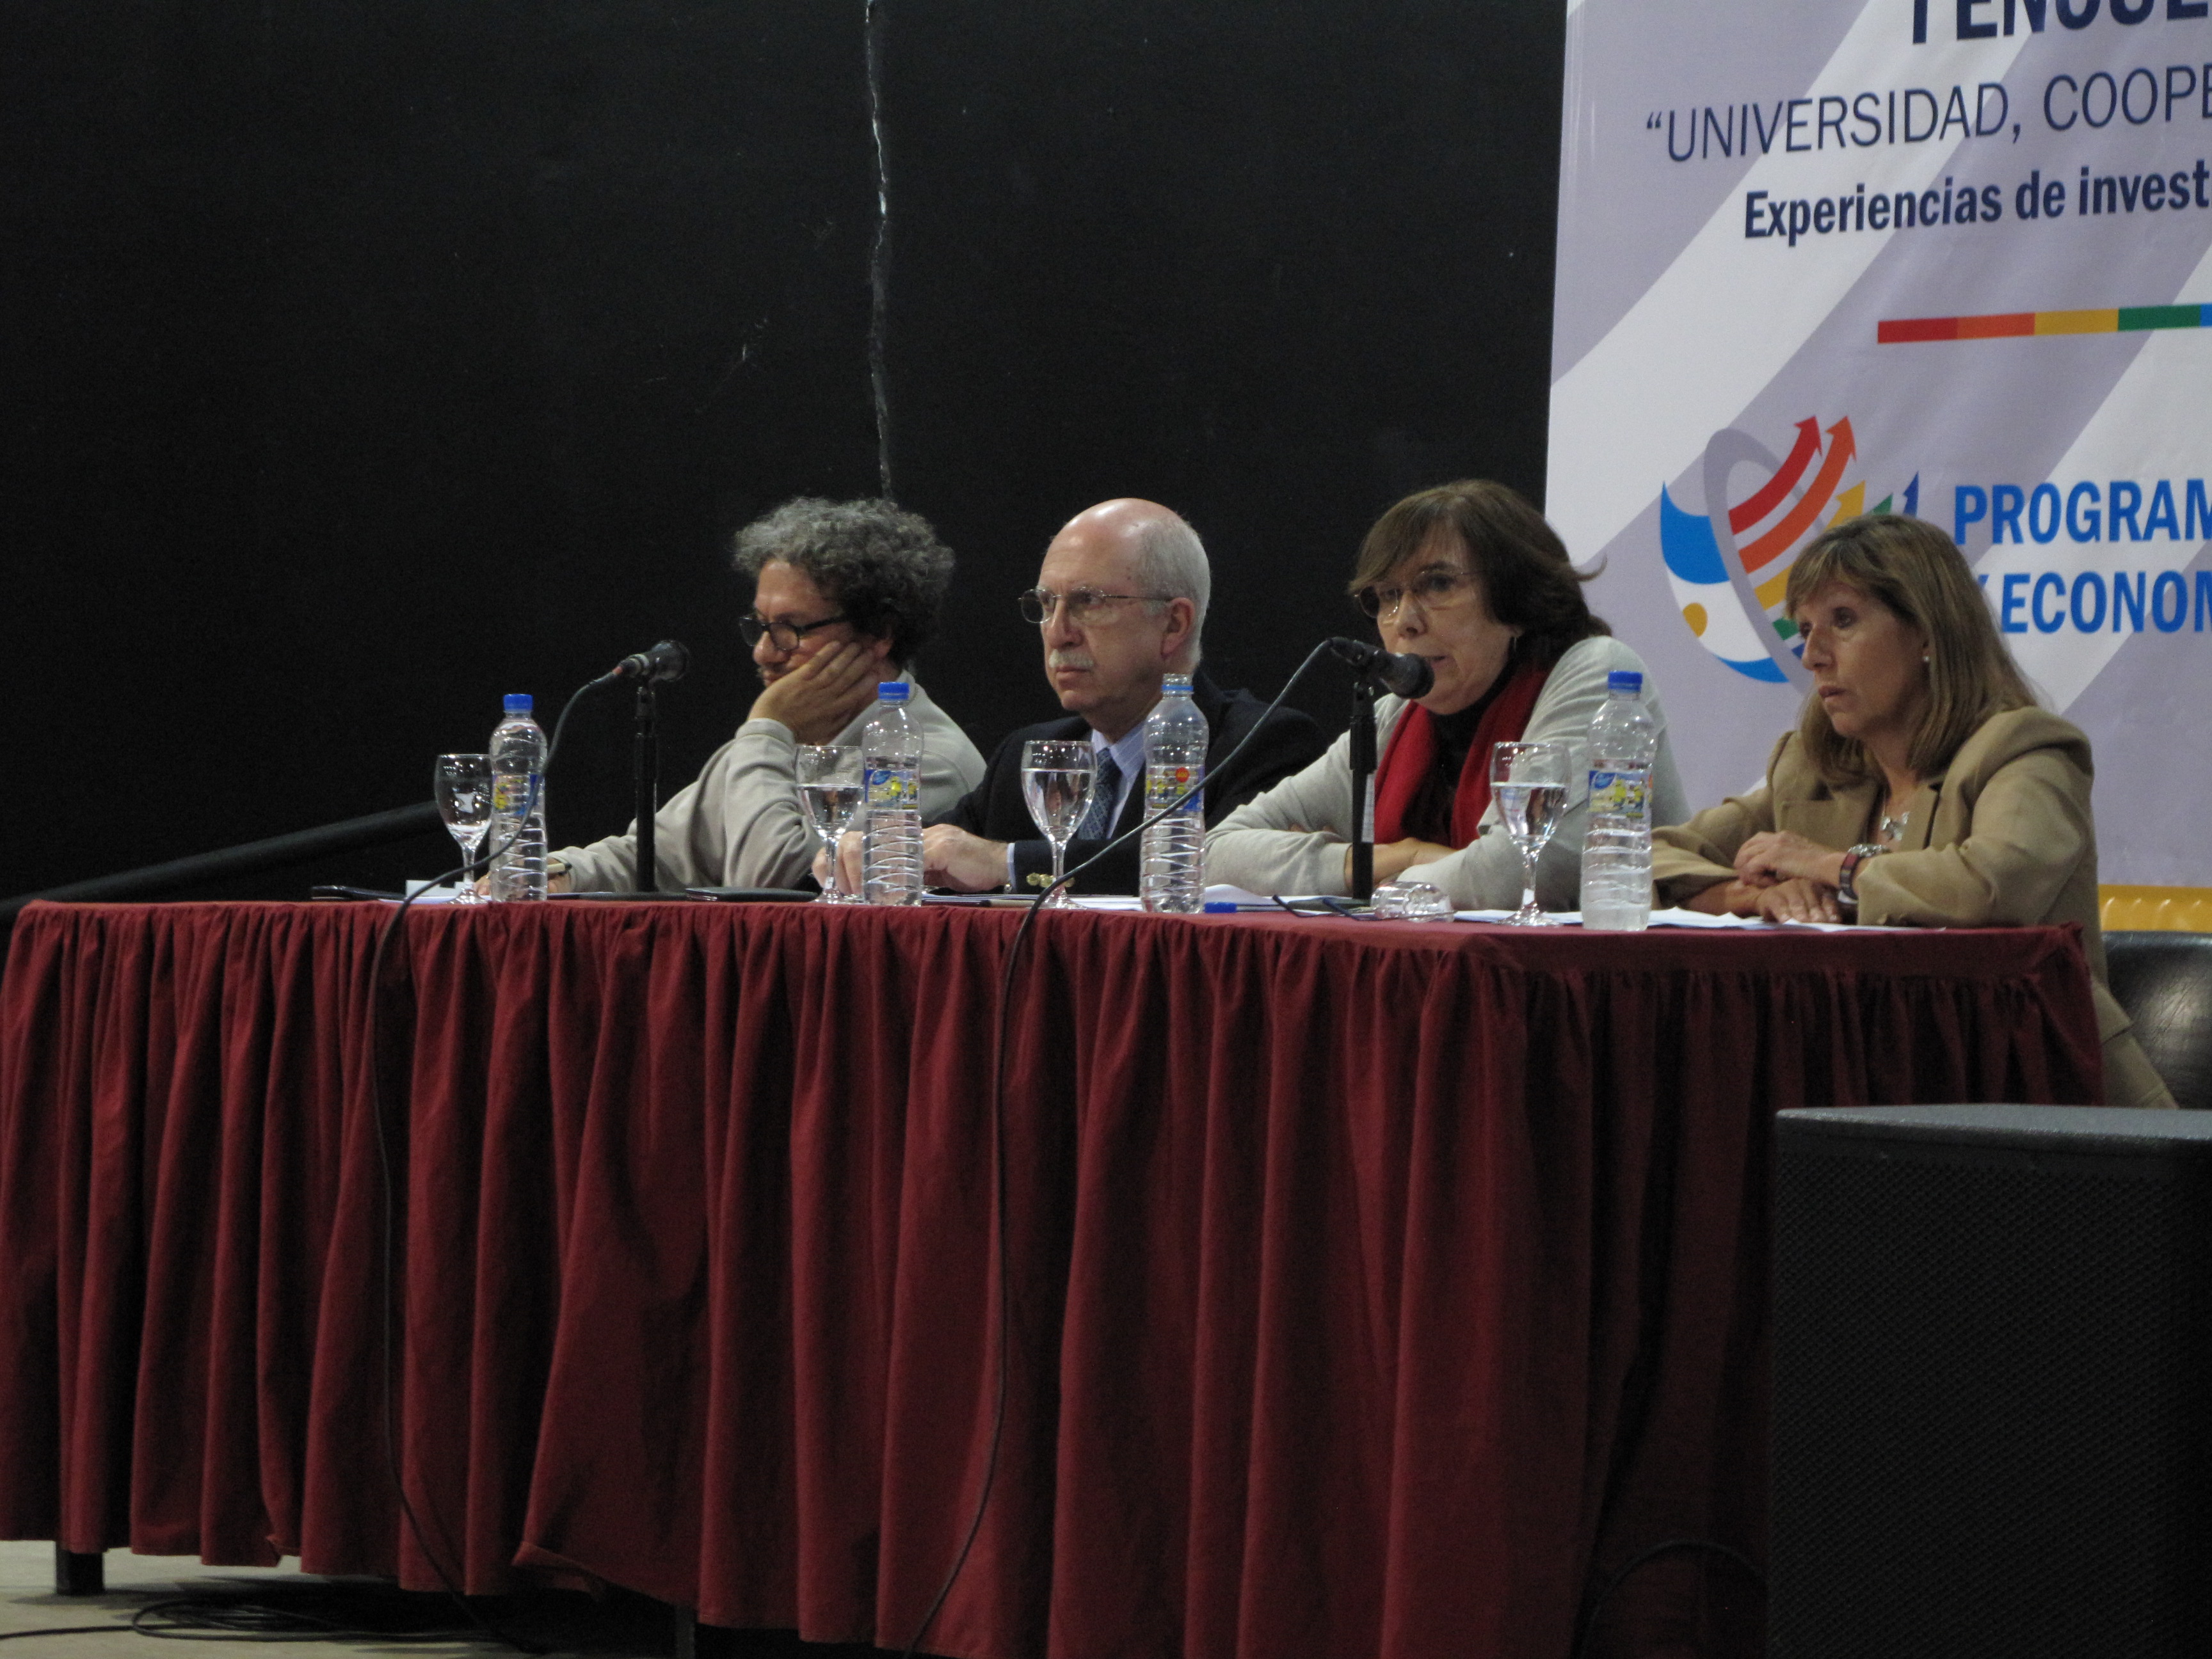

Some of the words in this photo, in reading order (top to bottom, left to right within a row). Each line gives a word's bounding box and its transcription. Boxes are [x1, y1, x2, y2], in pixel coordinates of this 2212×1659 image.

[1646, 82, 2021, 164] “UNIVERSIDAD,
[1744, 176, 2003, 246] Experiencias
[2015, 169, 2066, 221] de
[2078, 158, 2210, 216] invest
[1954, 477, 2212, 545] PROGRAM
